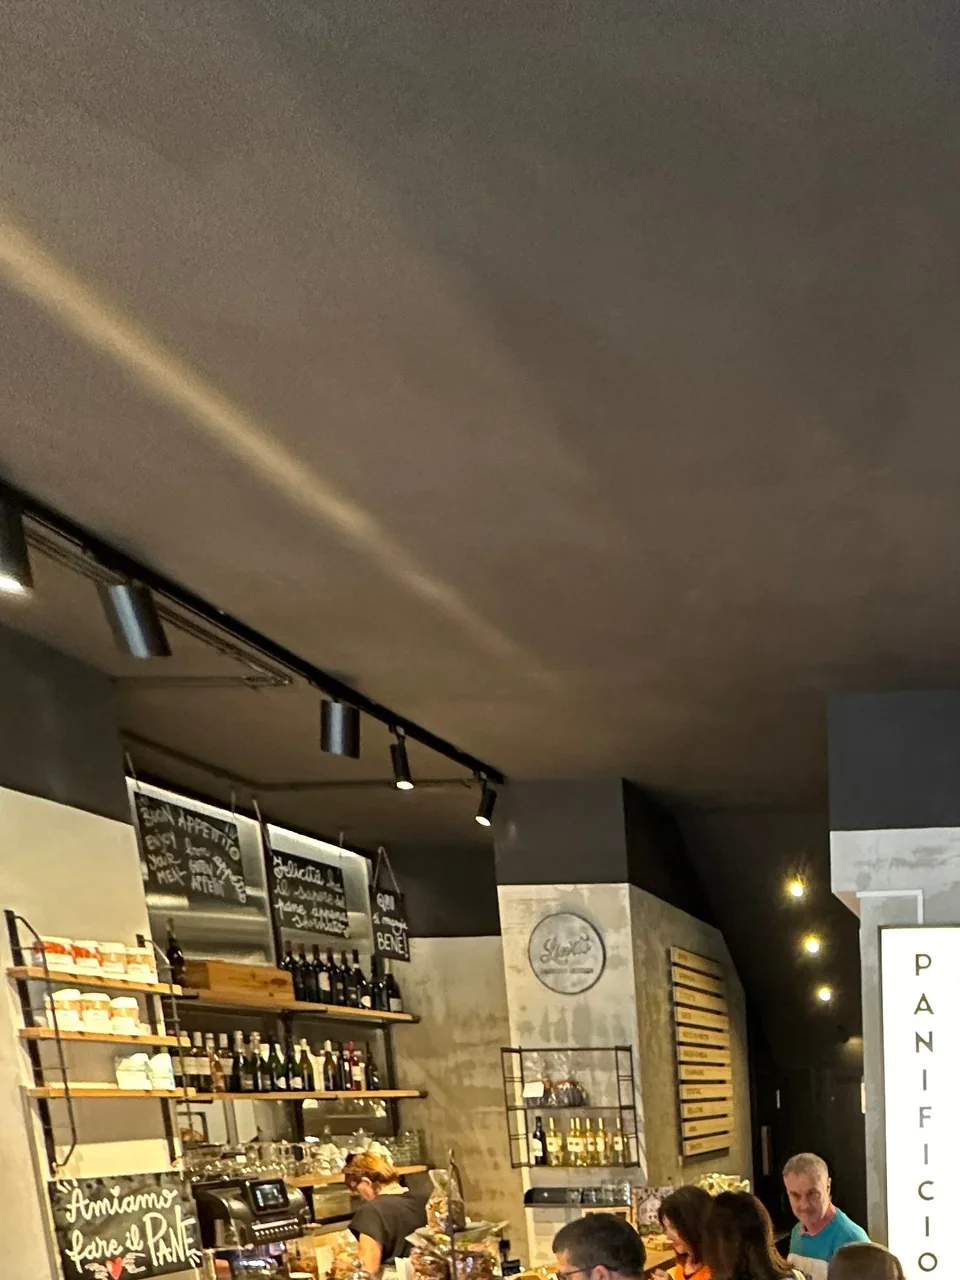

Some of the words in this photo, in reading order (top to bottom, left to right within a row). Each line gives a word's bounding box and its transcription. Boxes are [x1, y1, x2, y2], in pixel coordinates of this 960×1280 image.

[274, 898, 307, 920] pane
[376, 893, 395, 912] QUI
[376, 931, 409, 958] BENE!
[913, 953, 938, 1272] PANIFICIO
[66, 1186, 178, 1223] Amiamo
[65, 1229, 123, 1273] fare
[125, 1224, 144, 1251] il
[143, 1204, 197, 1267] PANE
